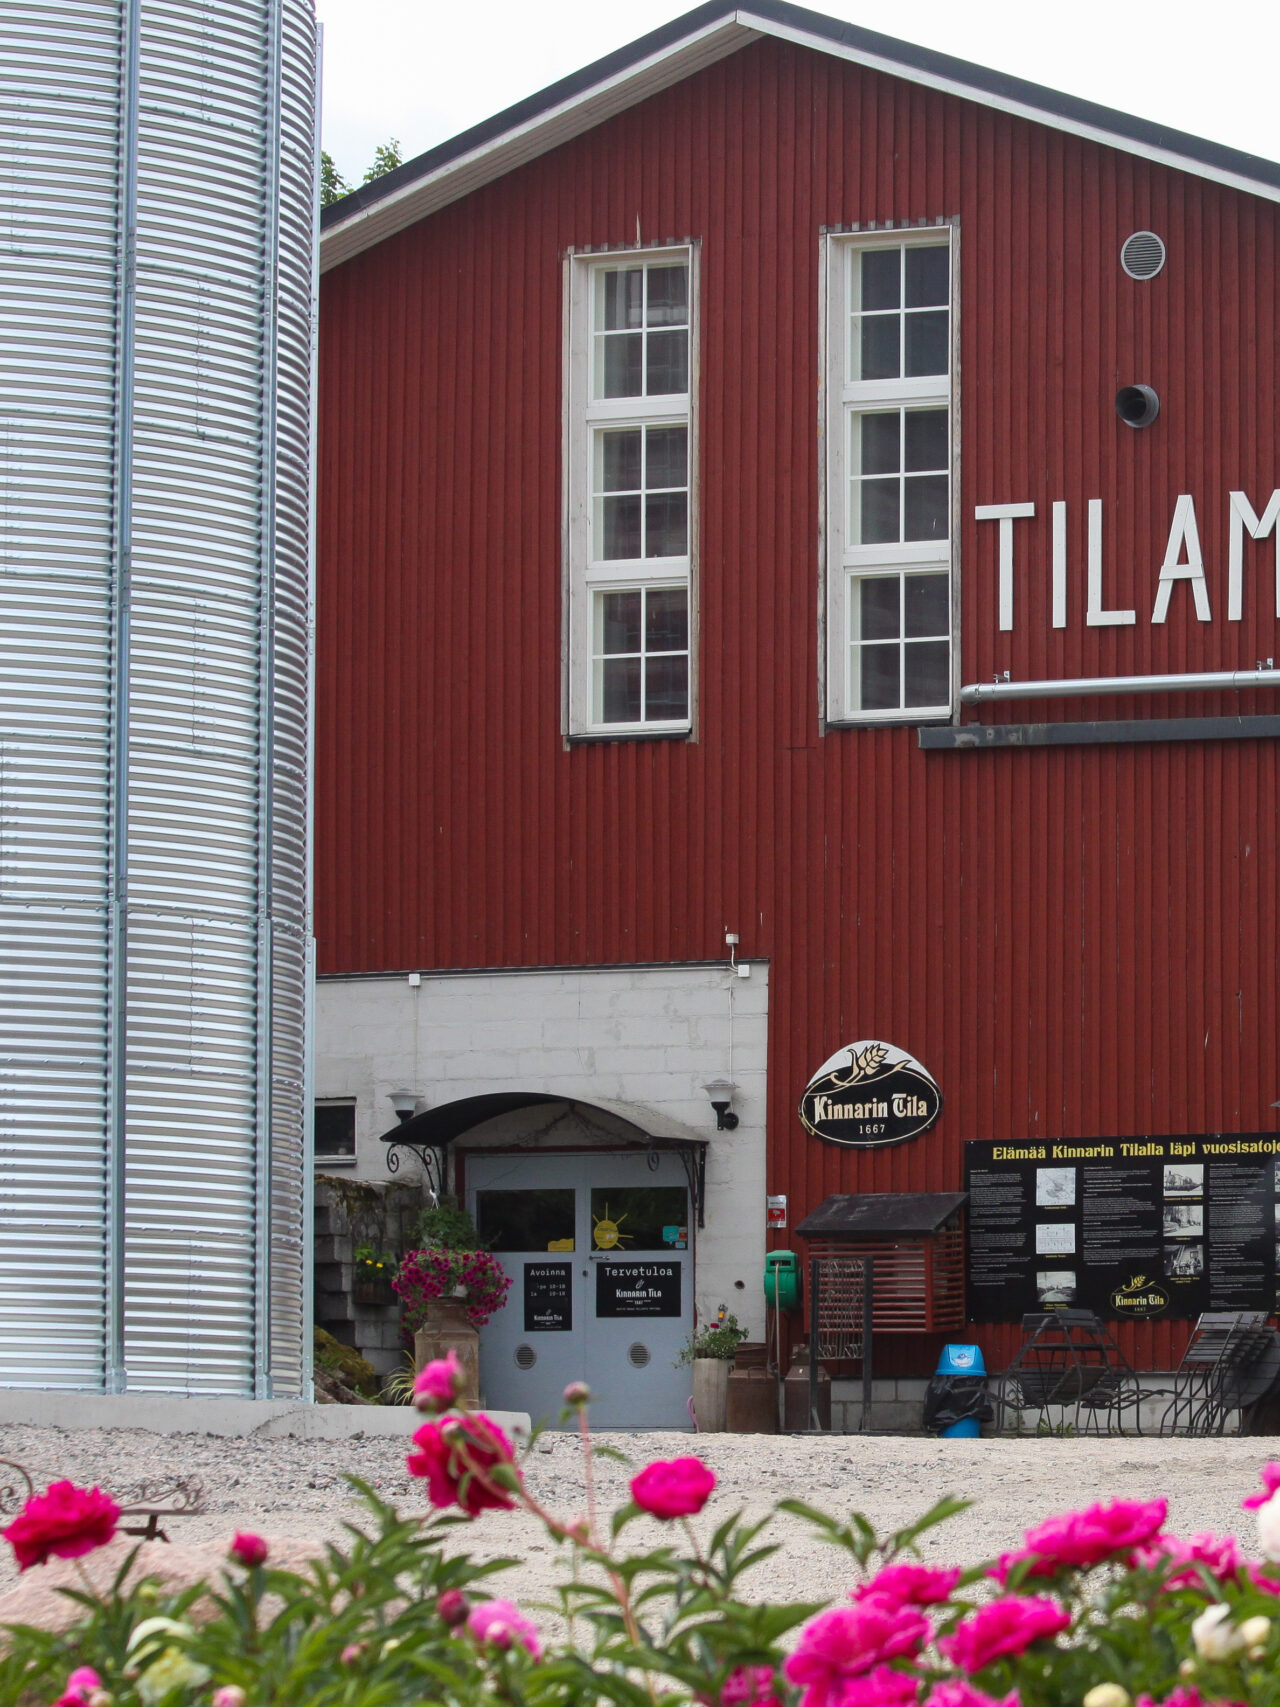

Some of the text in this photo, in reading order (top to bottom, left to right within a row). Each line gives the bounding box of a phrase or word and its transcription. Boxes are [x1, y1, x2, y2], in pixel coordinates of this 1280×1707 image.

[813, 1093, 928, 1125] Kinnarin Tila
[859, 1124, 886, 1135] 1667
[992, 1146, 1047, 1160] Elämää
[1052, 1144, 1115, 1159] Kinnarin
[1120, 1143, 1165, 1157] Tilalla
[1169, 1141, 1197, 1157] läpi
[530, 1268, 566, 1276] Avoinna
[605, 1266, 673, 1276] Tervetuloa
[1115, 1294, 1165, 1307] Kinnarin Tila
